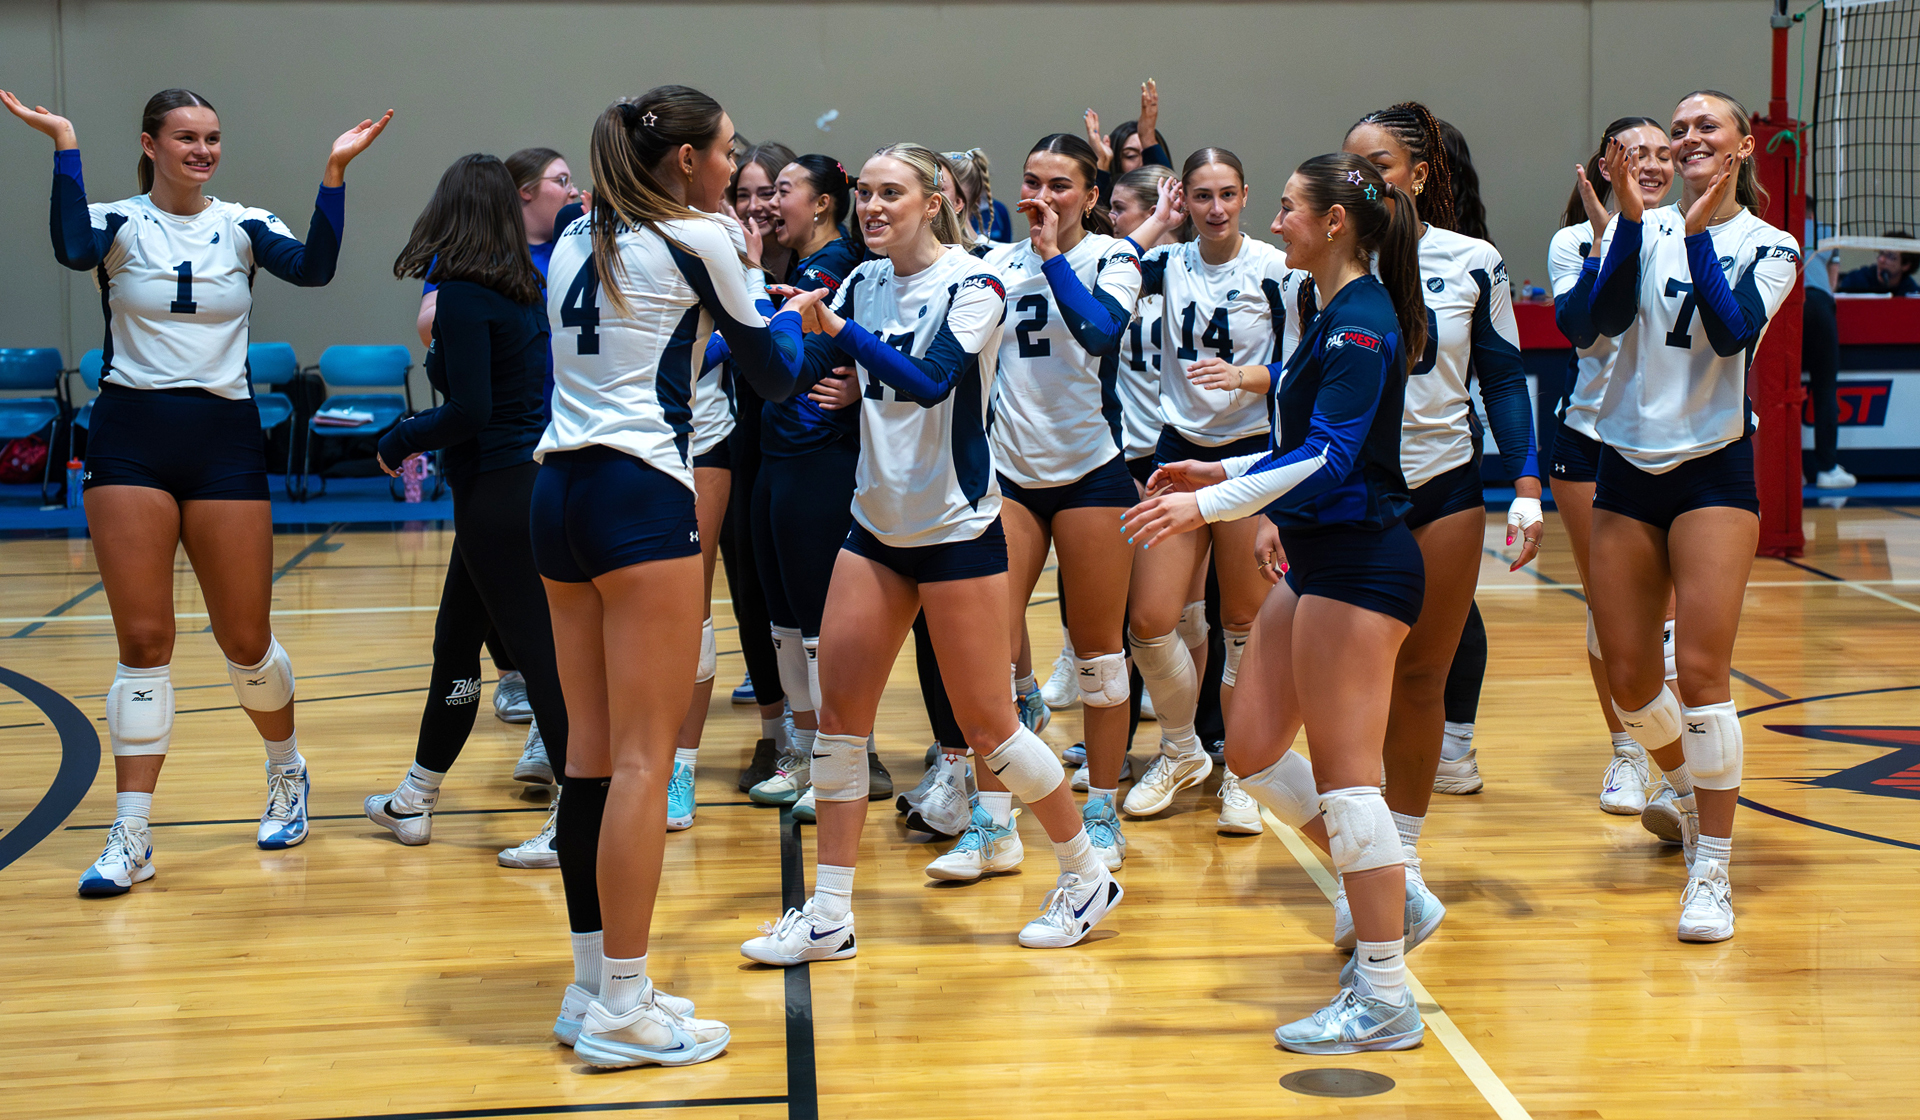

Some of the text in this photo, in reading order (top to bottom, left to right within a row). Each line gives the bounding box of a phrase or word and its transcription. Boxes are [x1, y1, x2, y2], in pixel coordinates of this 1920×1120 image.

[563, 218, 643, 237] CAPNO
[170, 260, 197, 314] 1
[560, 250, 600, 355] 4
[1664, 276, 1698, 350] 7
[1015, 293, 1051, 358] 2
[1177, 300, 1234, 364] 14
[1325, 332, 1380, 349] PACWEST
